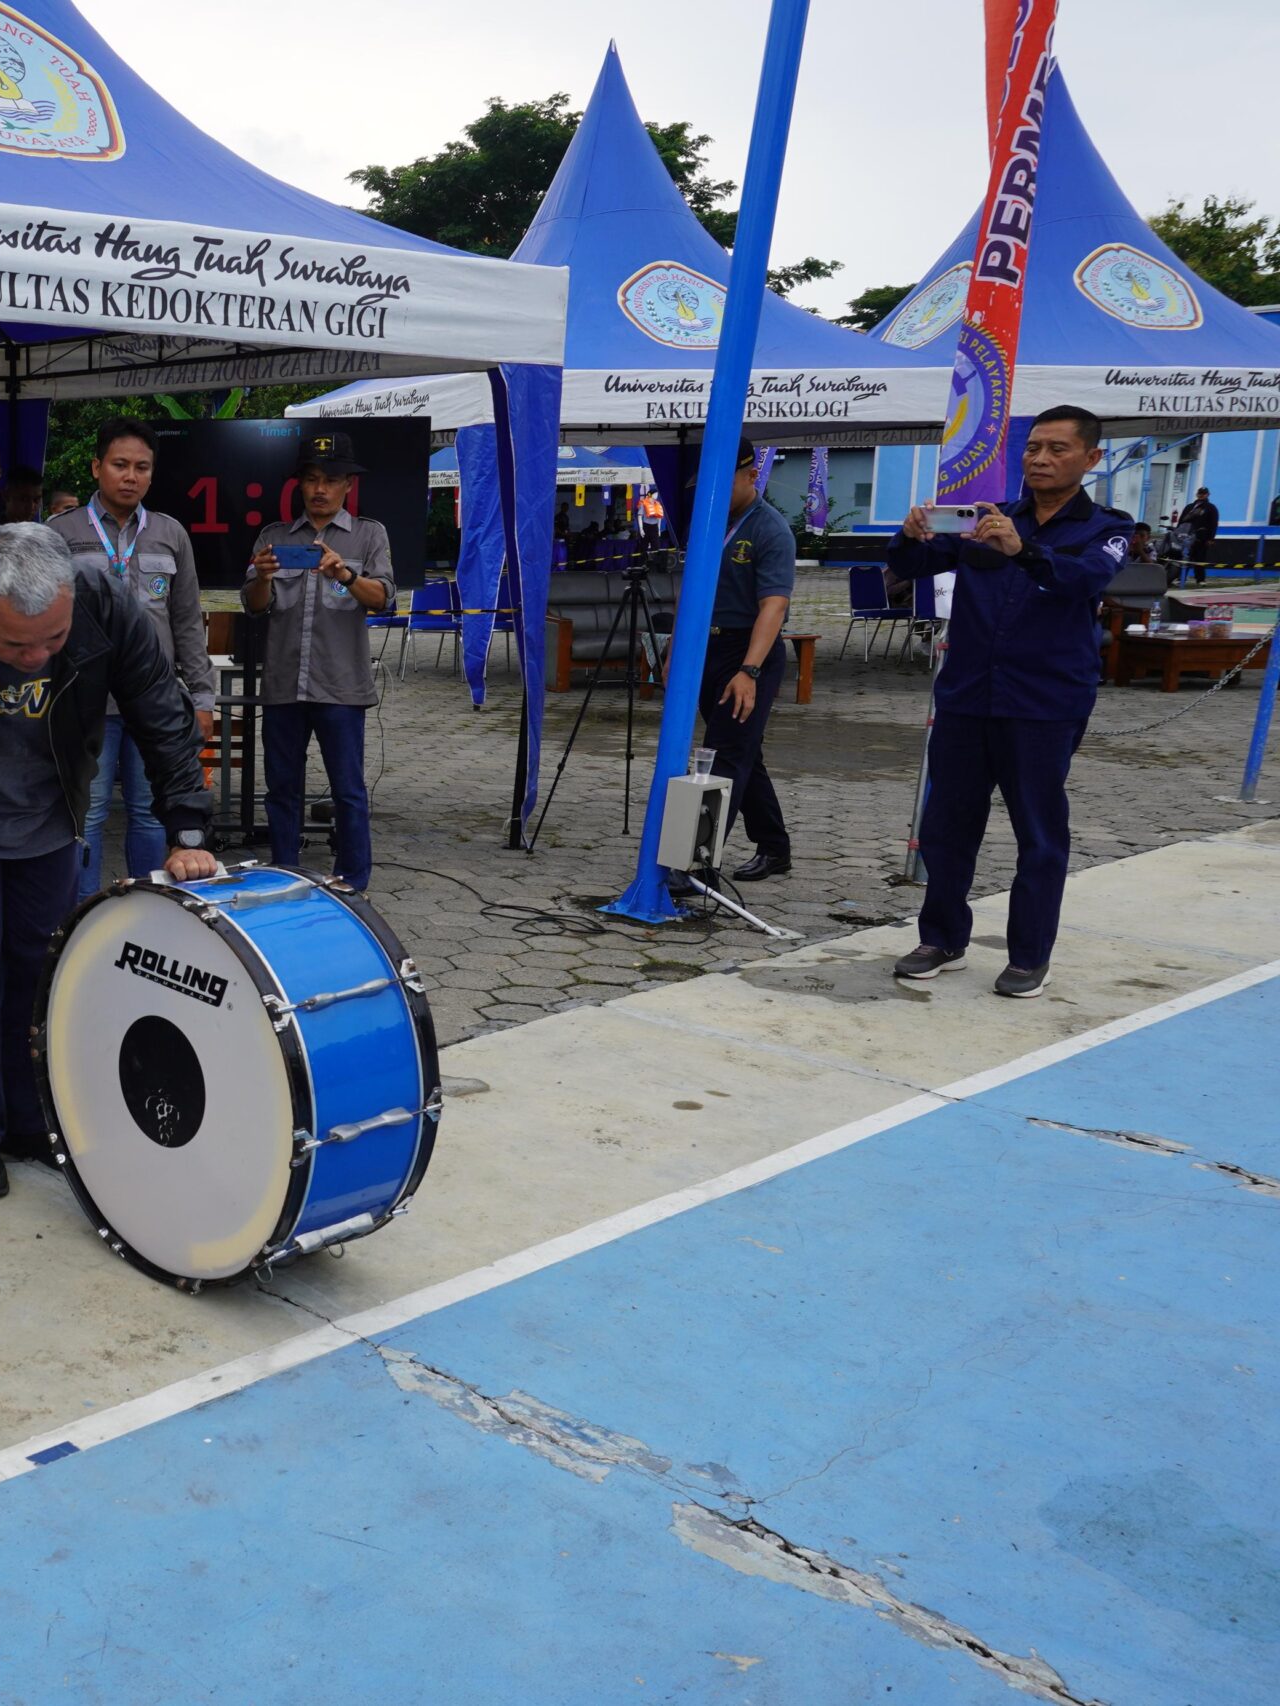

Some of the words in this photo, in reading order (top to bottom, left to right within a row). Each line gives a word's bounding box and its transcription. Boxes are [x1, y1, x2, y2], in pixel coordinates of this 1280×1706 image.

[50, 55, 94, 102] TUAH
[94, 222, 198, 281] Hang
[193, 236, 272, 287] Tuah
[274, 247, 410, 306] Surabaya
[101, 283, 318, 338] KEDOKTERAN
[325, 302, 389, 340] GIGI
[634, 273, 669, 315] UNIVERSITAS
[671, 273, 704, 289] HANG
[604, 374, 704, 393] Universitas
[761, 373, 805, 397] Tuah
[806, 375, 887, 400] Surabaya
[969, 337, 1002, 419] PELAYARAN
[1105, 368, 1196, 386] Universitas
[1201, 370, 1247, 394] Hang
[374, 392, 393, 413] Tuah
[393, 389, 430, 413] Surabaya
[646, 401, 707, 419] FAKUL
[746, 401, 849, 418] PSIKOLOGI
[1138, 395, 1224, 412] FAKULTAS
[1228, 396, 1280, 412] PSIKO
[258, 426, 293, 437] Timer
[295, 426, 301, 436] 1
[952, 440, 987, 474] TUAH
[114, 941, 228, 1007] ROLLING
[136, 968, 214, 1004] DRUMHEADS
